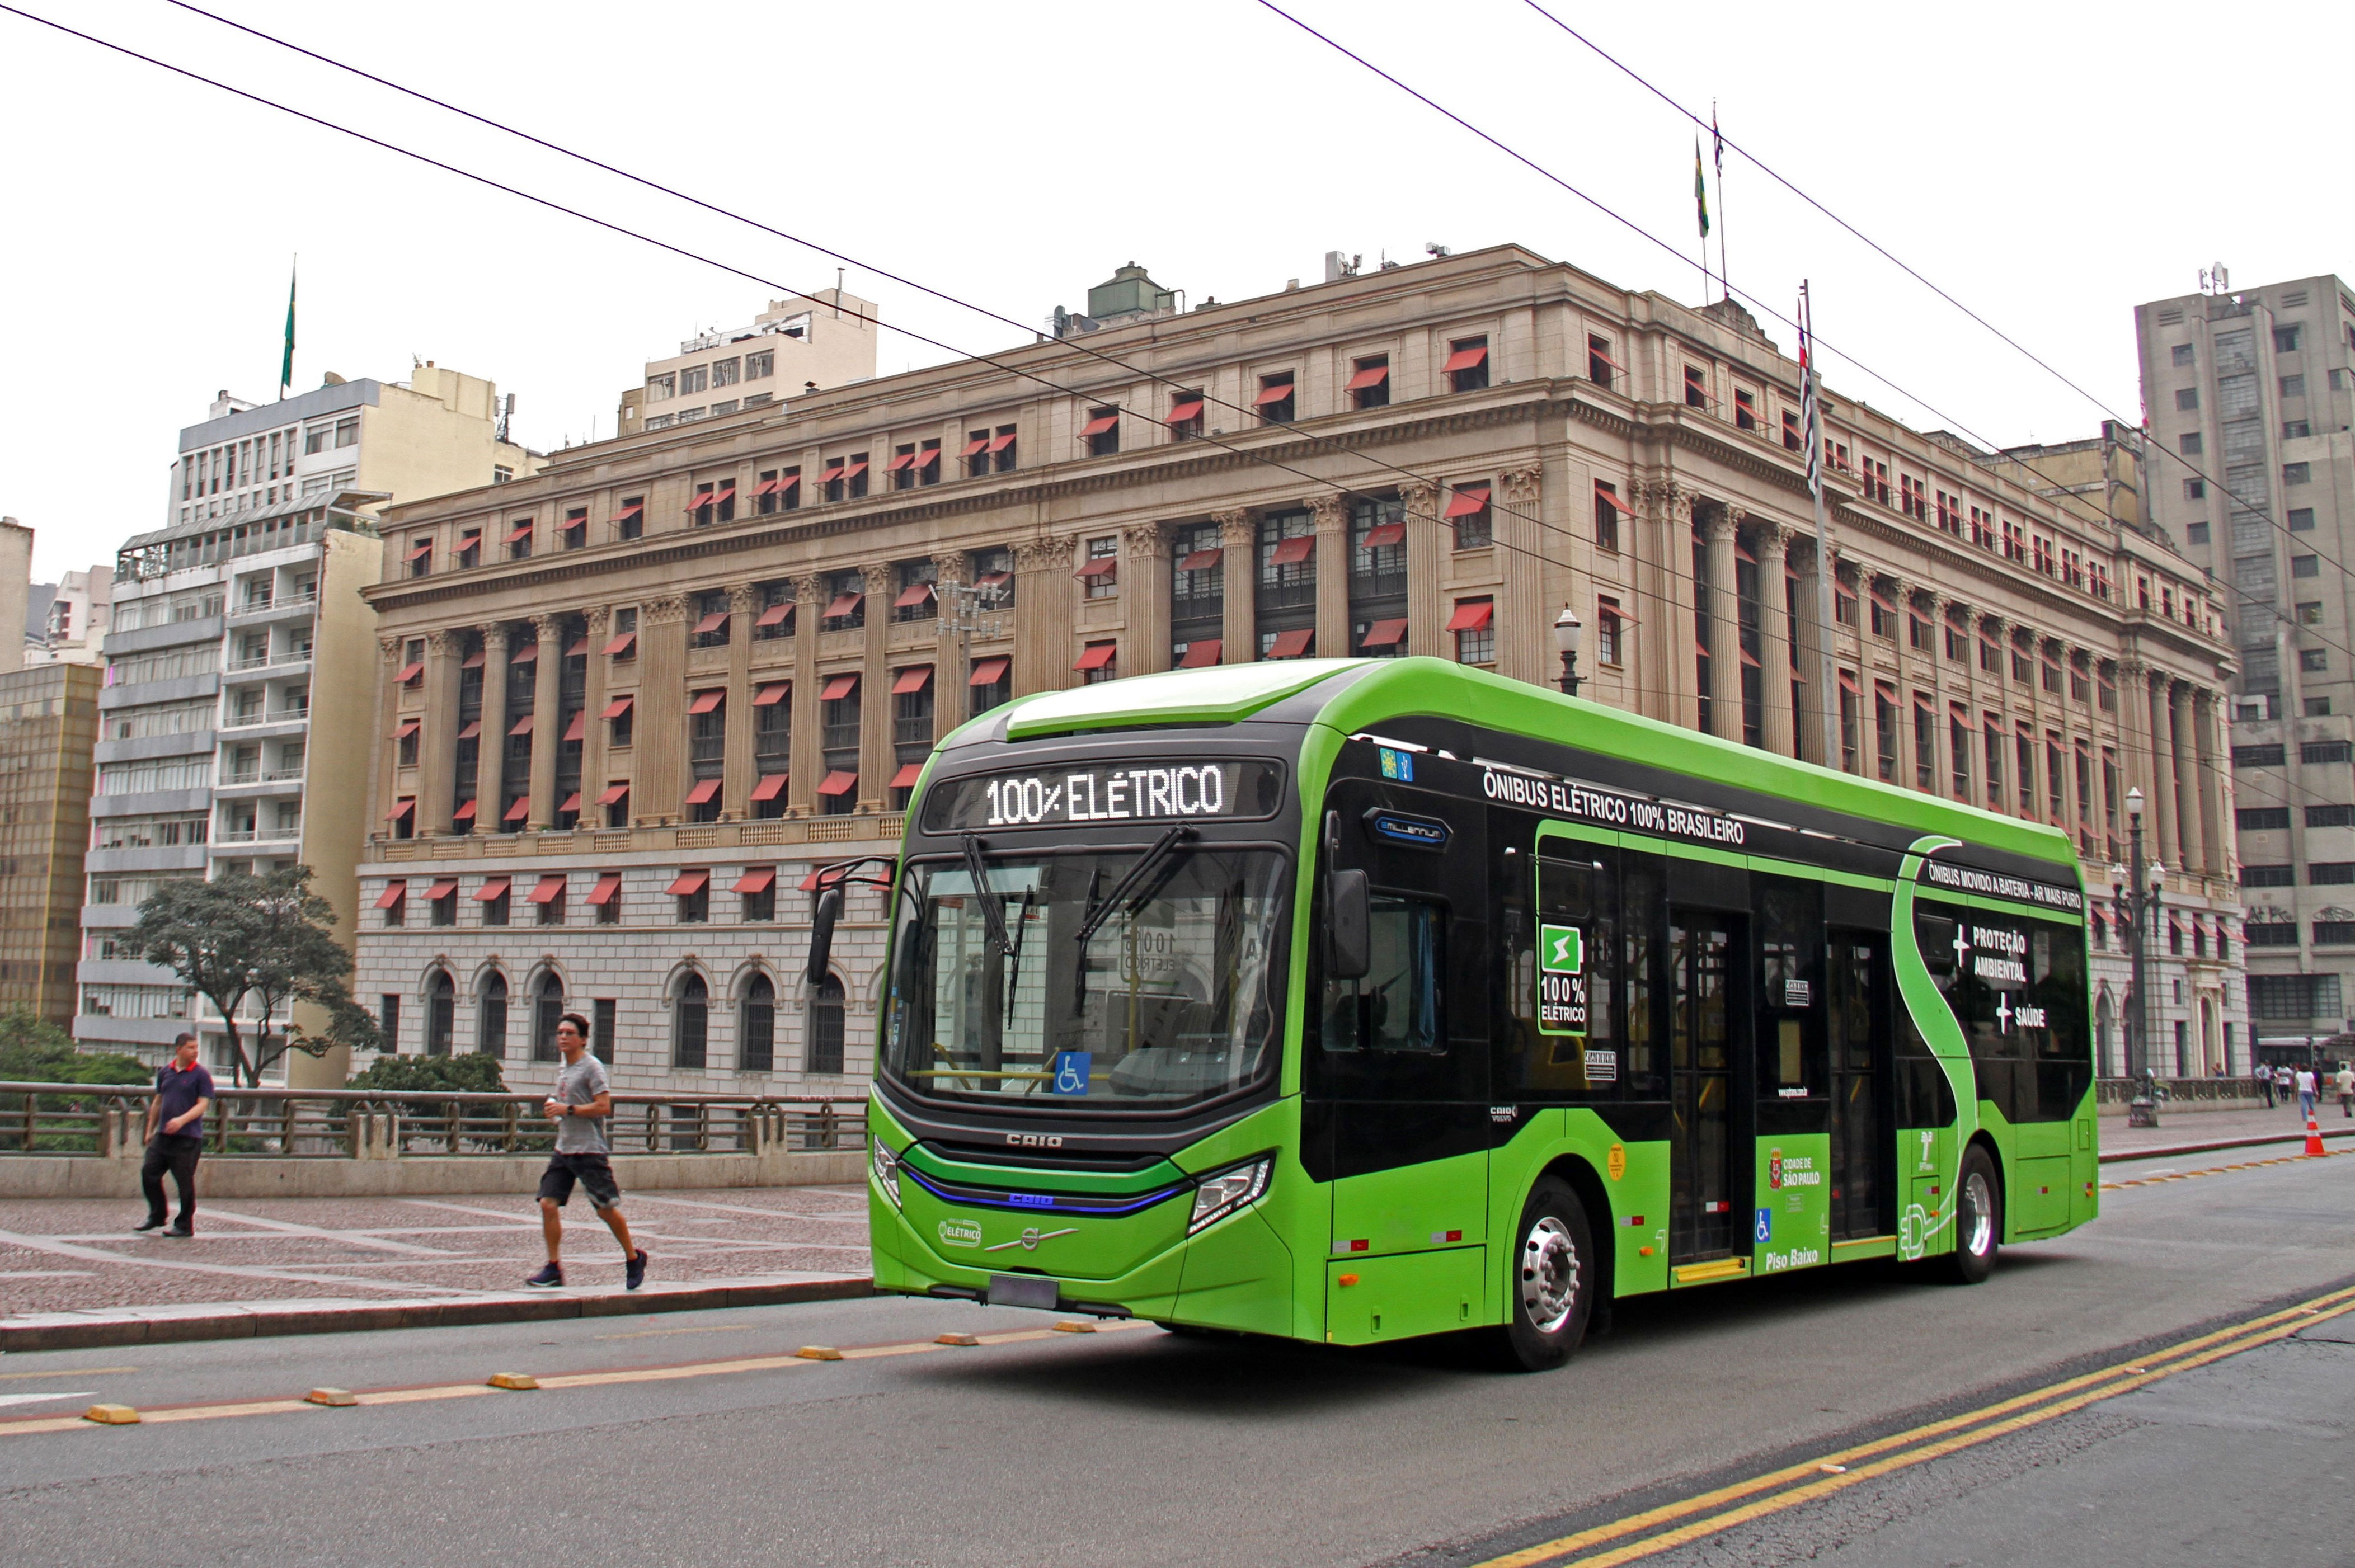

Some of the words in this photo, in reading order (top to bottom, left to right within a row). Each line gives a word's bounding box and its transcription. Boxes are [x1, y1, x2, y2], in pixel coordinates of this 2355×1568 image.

[987, 778, 1061, 825] 100%
[1068, 765, 1221, 821] ELÉTRICO
[1483, 766, 1548, 808] ÔNIBUS
[1552, 783, 1626, 826] ELÉTRICO
[1629, 801, 1665, 831] 100%
[1667, 808, 1744, 845] BRASILEIRO
[1928, 860, 1960, 888] ÔNIBUS
[1961, 871, 1992, 893] MOVIDO
[1992, 880, 2000, 894] A
[1999, 880, 2030, 900] BATERIA
[2034, 886, 2044, 902] AR
[2044, 888, 2061, 906] MAIS
[2061, 891, 2081, 910] PURO
[1973, 926, 2025, 956] PROTEÇÃO
[1975, 957, 2026, 982] AMBIENTAL
[1541, 976, 1584, 1003] 100%
[1541, 1002, 1585, 1021] ELÉTRICO
[2015, 1004, 2046, 1028] SAÚDE
[1007, 1134, 1062, 1147] CAIO
[1784, 1158, 1803, 1169] CIDADE
[1804, 1157, 1811, 1168] DE
[1783, 1170, 1798, 1186] SÃO
[1798, 1171, 1820, 1186] PAULO
[1009, 1194, 1054, 1204] CAIO
[947, 1226, 981, 1239] ELÉTRICO
[1766, 1251, 1788, 1271] Piso
[1791, 1247, 1818, 1265] Baixo
